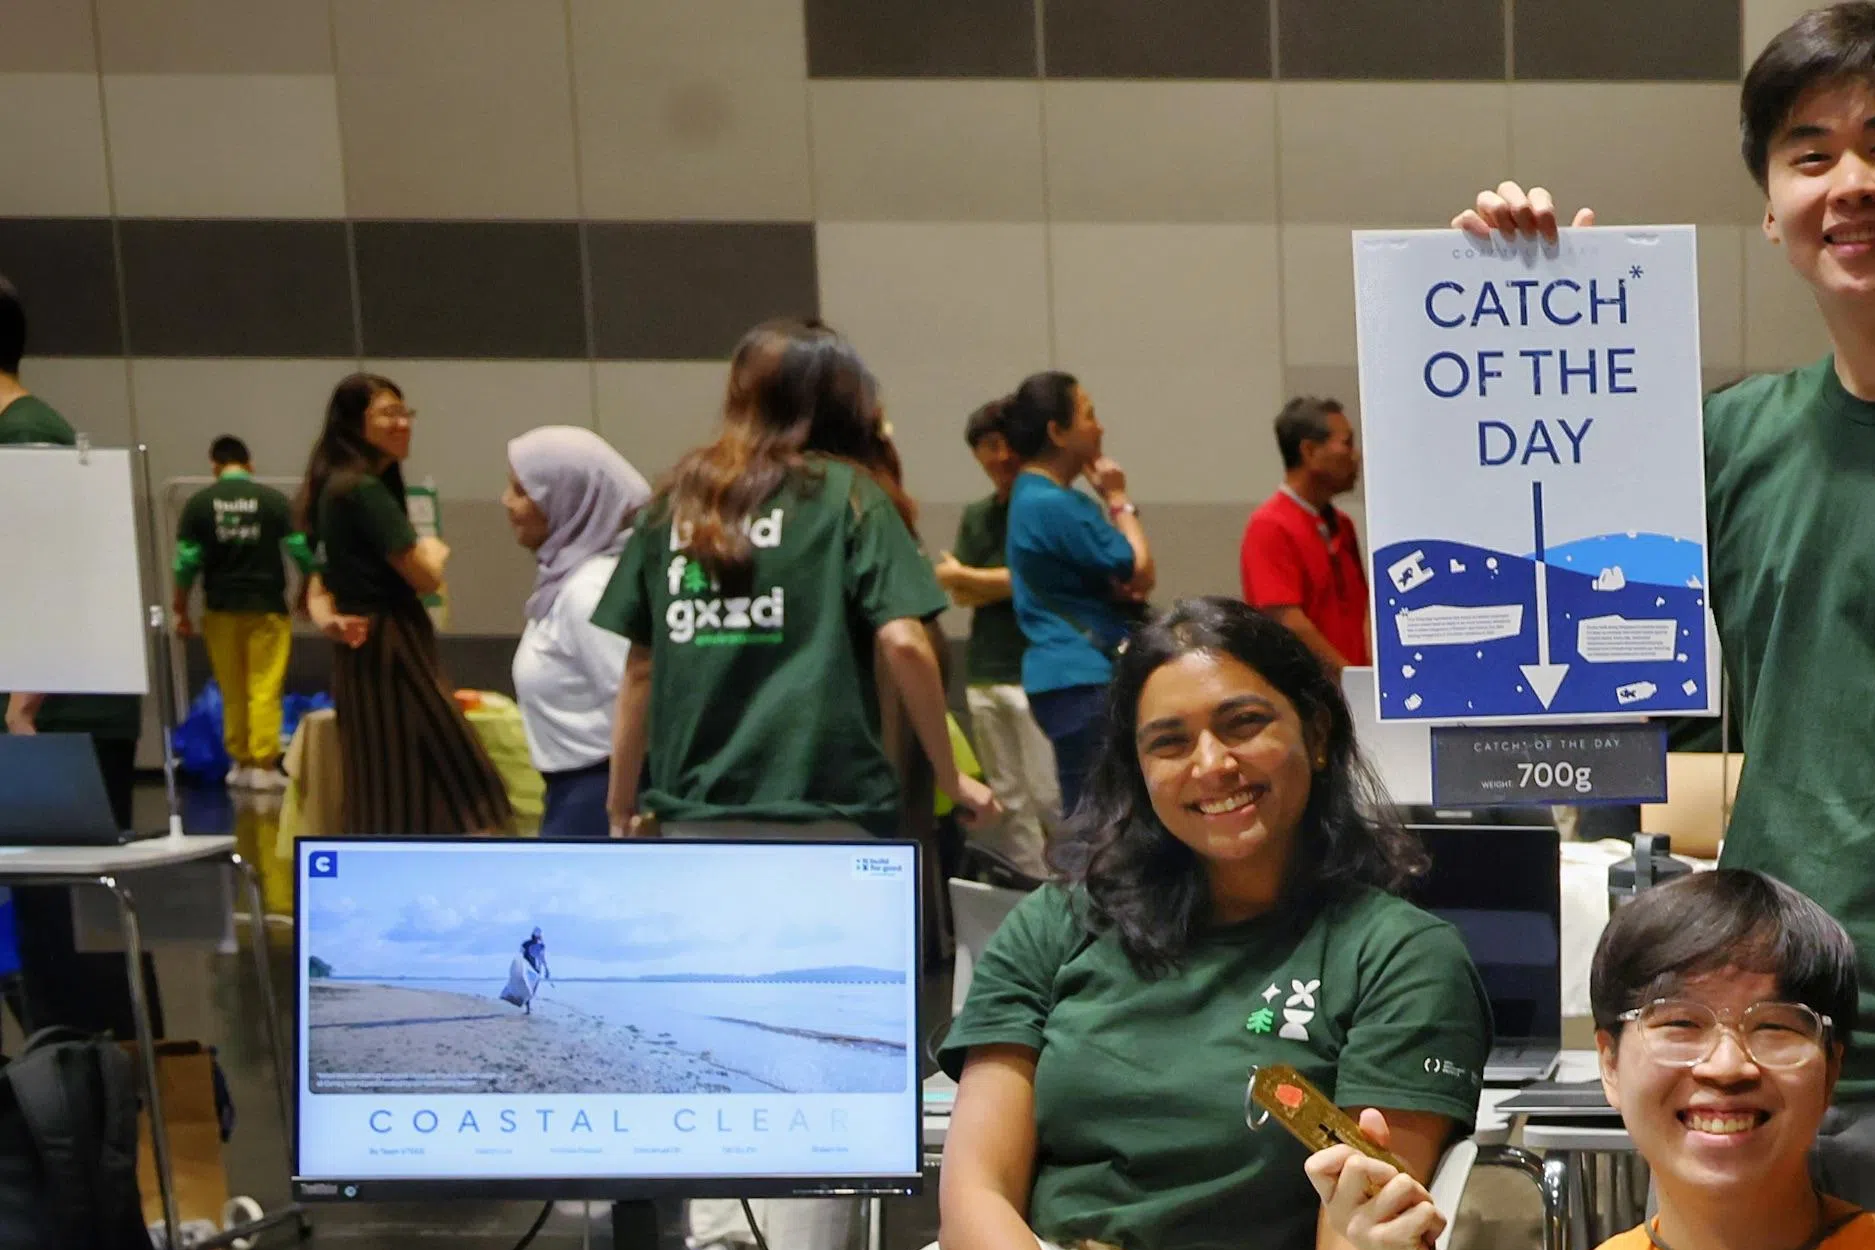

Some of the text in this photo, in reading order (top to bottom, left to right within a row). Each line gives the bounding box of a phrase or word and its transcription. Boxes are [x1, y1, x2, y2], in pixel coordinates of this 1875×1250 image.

[1423, 347, 1637, 398] OF THE
[1477, 418, 1594, 466] DAY
[1535, 740, 1551, 750] OF
[1561, 739, 1585, 749] THE
[1594, 739, 1621, 749] DAY
[1517, 761, 1592, 793] 700g
[315, 856, 331, 873] C
[369, 1108, 848, 1134] COASTAL CLEAR
